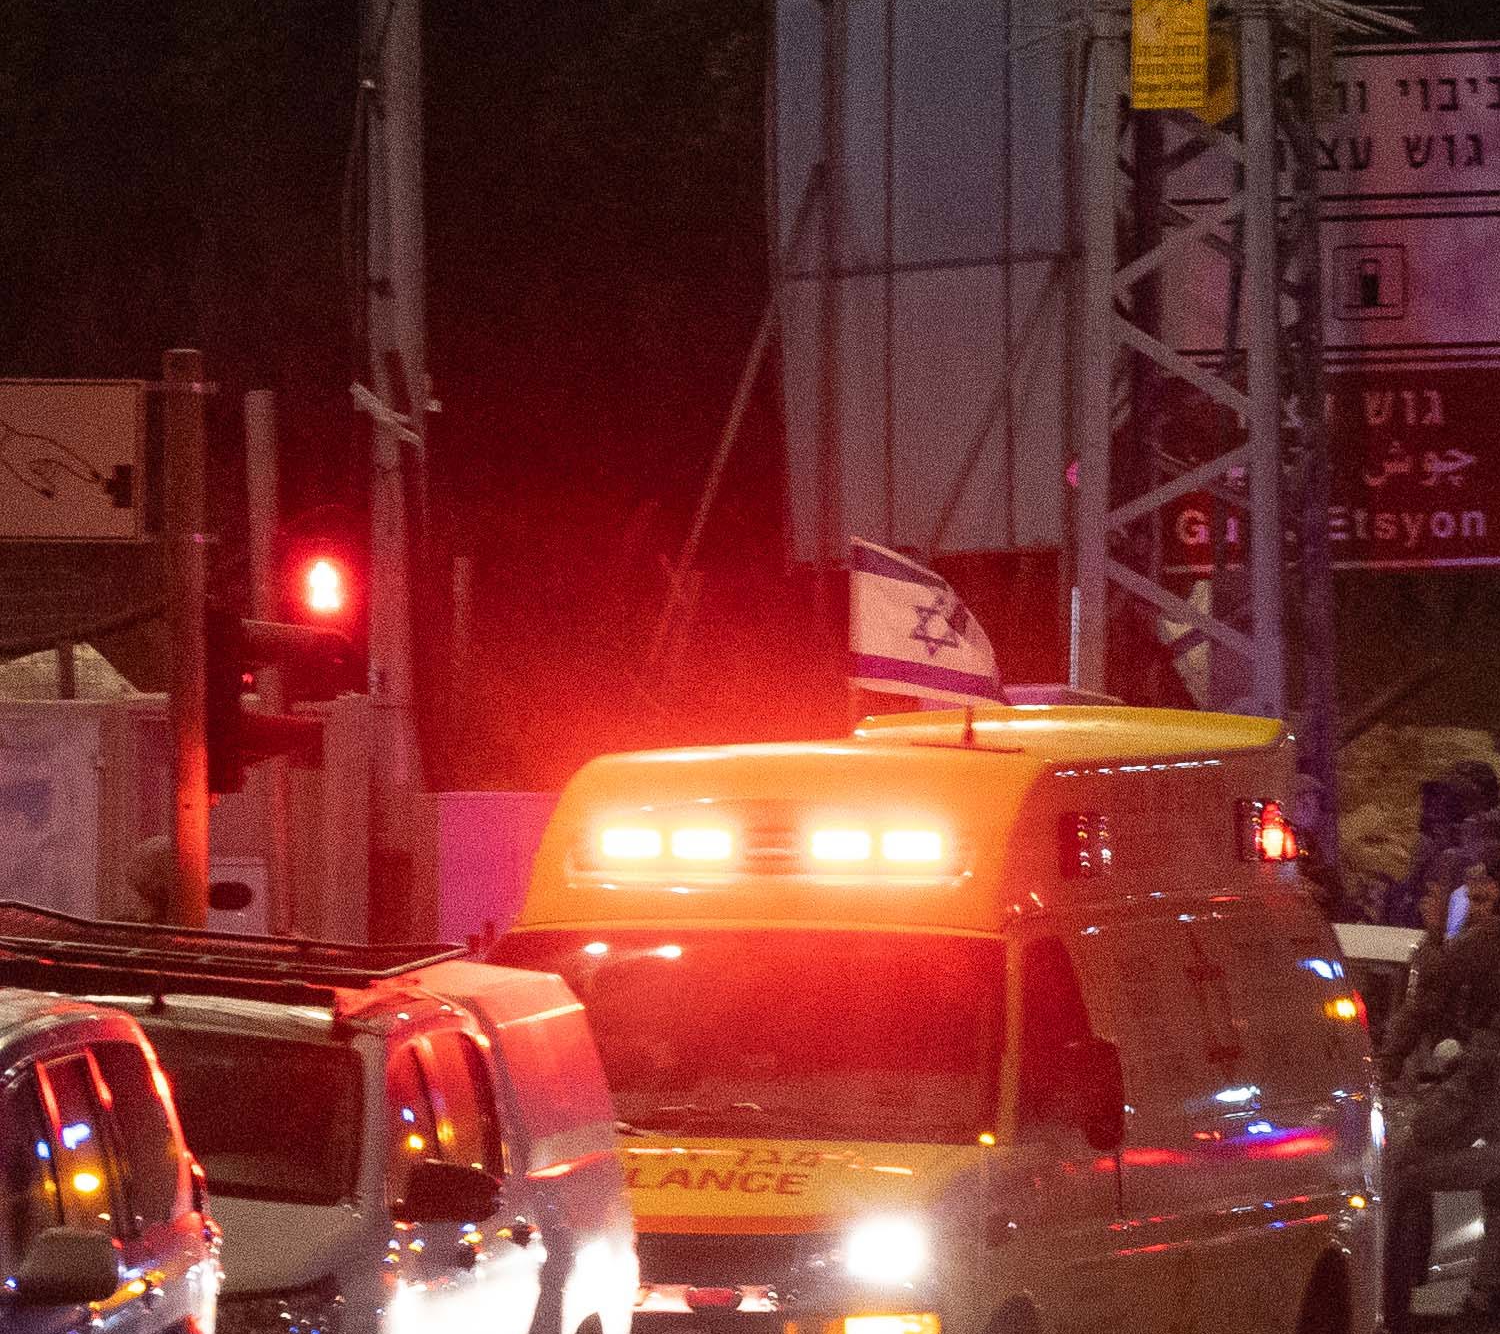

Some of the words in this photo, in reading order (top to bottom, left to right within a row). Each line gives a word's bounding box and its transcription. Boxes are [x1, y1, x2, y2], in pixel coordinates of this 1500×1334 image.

[1403, 133, 1484, 169] גוש
[1363, 388, 1445, 427] גוש
[1327, 506, 1488, 549] Etsyon
[624, 1167, 809, 1195] LANCE
